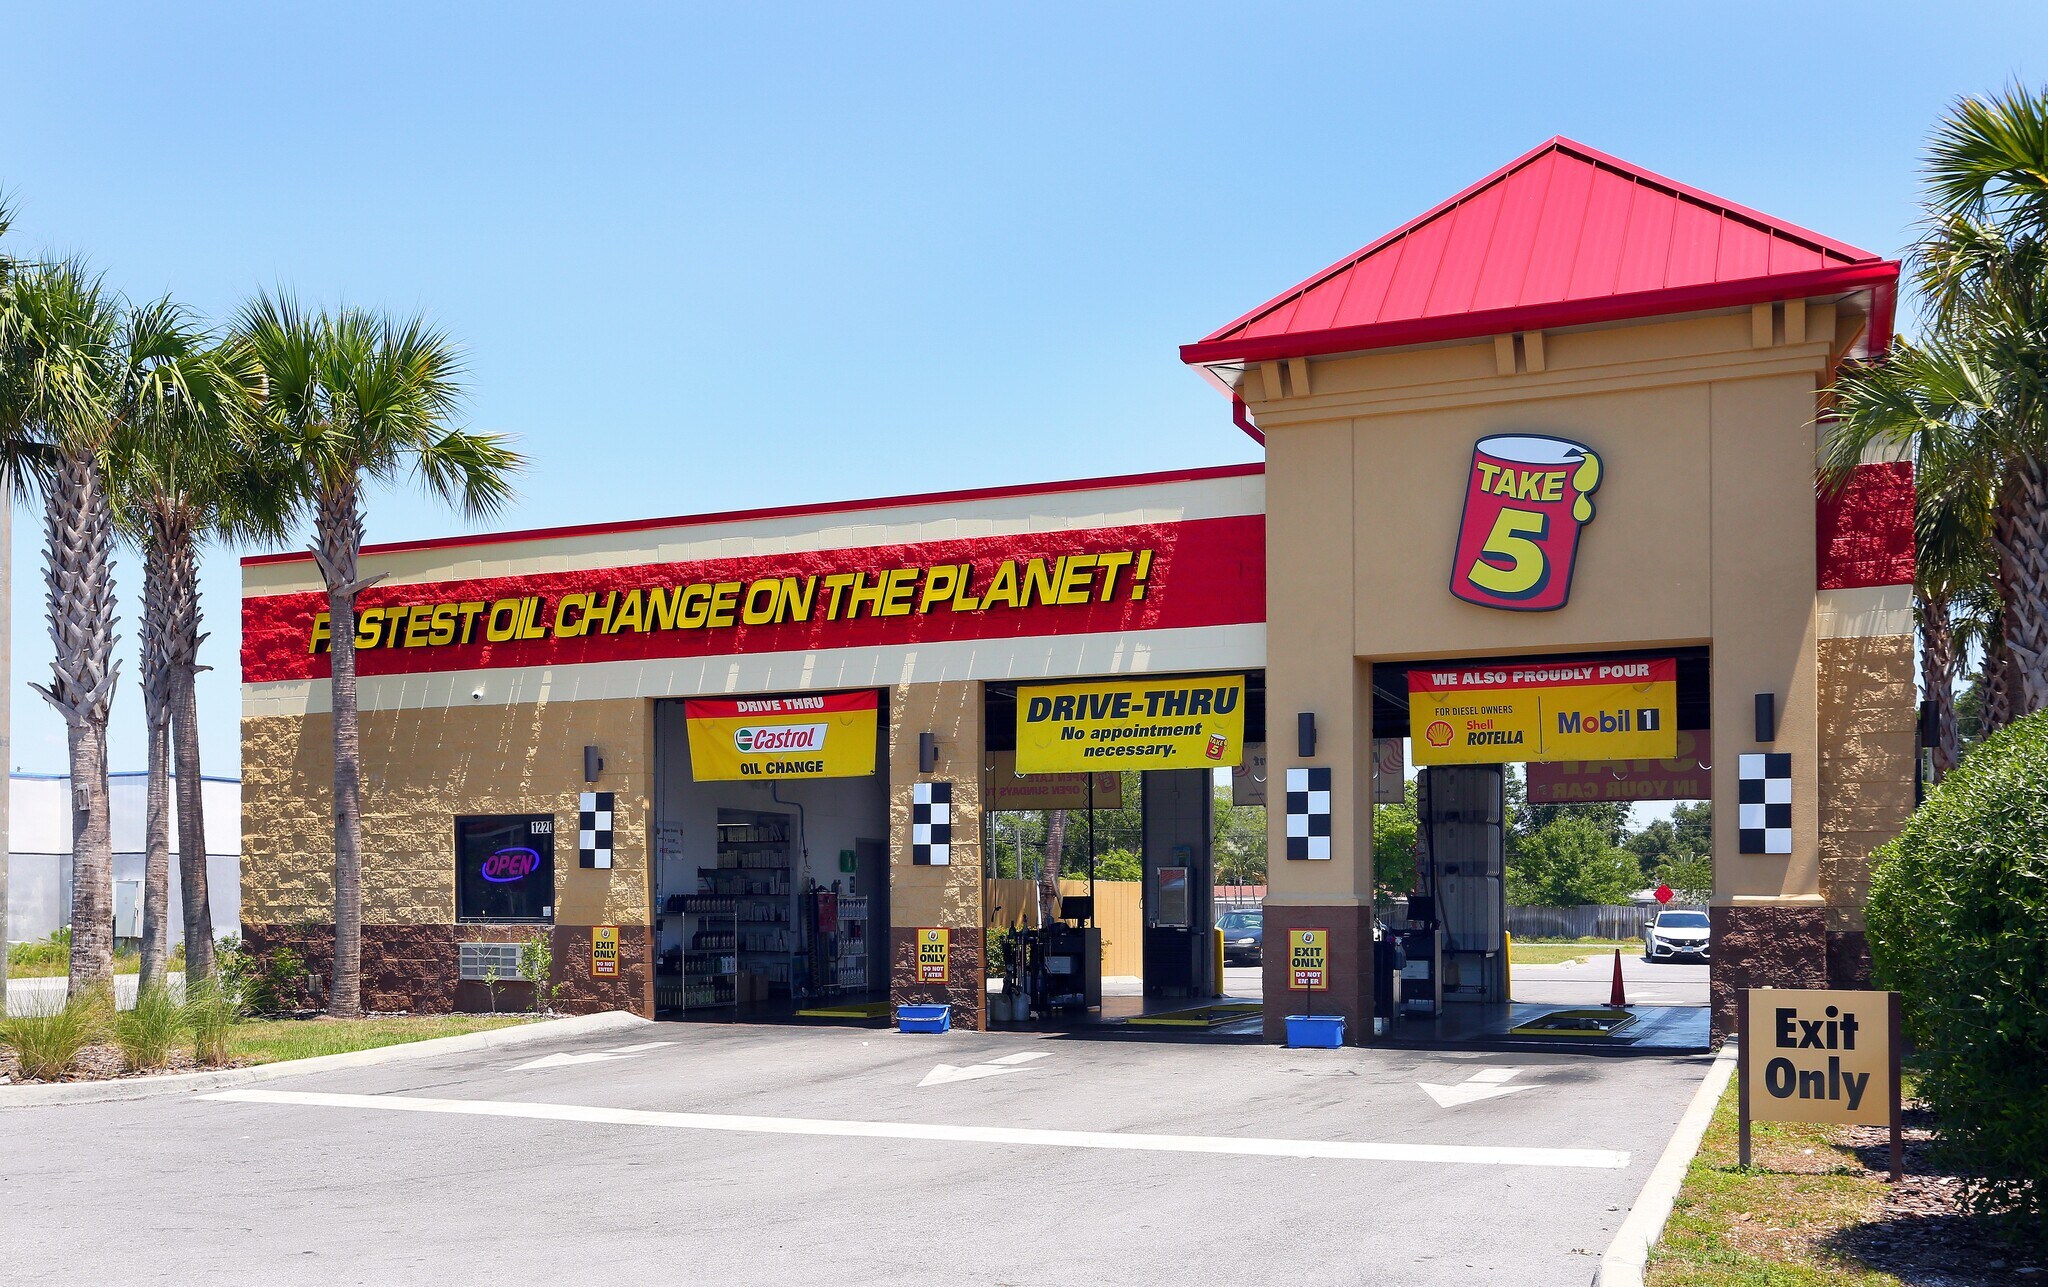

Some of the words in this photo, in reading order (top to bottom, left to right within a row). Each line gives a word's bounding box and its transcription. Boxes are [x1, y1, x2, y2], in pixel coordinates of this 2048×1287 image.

[1477, 461, 1567, 501] TAKE
[1467, 507, 1550, 600] 5
[308, 600, 486, 654] FSTEST
[486, 594, 549, 643] OIL
[553, 581, 743, 638] CHANGE
[743, 575, 818, 626] ON
[823, 568, 919, 621] THE
[1432, 672, 1457, 686] WE
[1462, 671, 1508, 685] ALSO
[1512, 667, 1593, 683] PROUDLY
[1599, 663, 1650, 678] POUR
[737, 700, 781, 713] DRIVE
[783, 697, 825, 710] THRU
[1026, 687, 1240, 724] DRIVE-THRU
[1435, 707, 1450, 717] FOR
[1452, 706, 1479, 716] DIESEL
[1481, 704, 1513, 715] OWNERS
[1466, 719, 1493, 731] Shell
[1558, 710, 1630, 734] Mobil
[753, 727, 815, 750] Castrol
[1060, 726, 1086, 741] No
[1089, 722, 1202, 743] appointment
[1467, 730, 1524, 746] ROTELLA
[1083, 741, 1177, 760] necessary.
[1210, 745, 1219, 755] 5
[740, 762, 762, 776] OIL
[766, 760, 823, 775] CHANGE
[486, 855, 533, 875] OPEN
[594, 950, 616, 958] ONLY
[596, 941, 615, 949] EXIT
[1295, 948, 1321, 956] EXIT
[920, 954, 946, 962] ONLY
[1292, 958, 1324, 967] ONLY
[1775, 1005, 1859, 1050] Exit
[1765, 1056, 1870, 1110] Only
